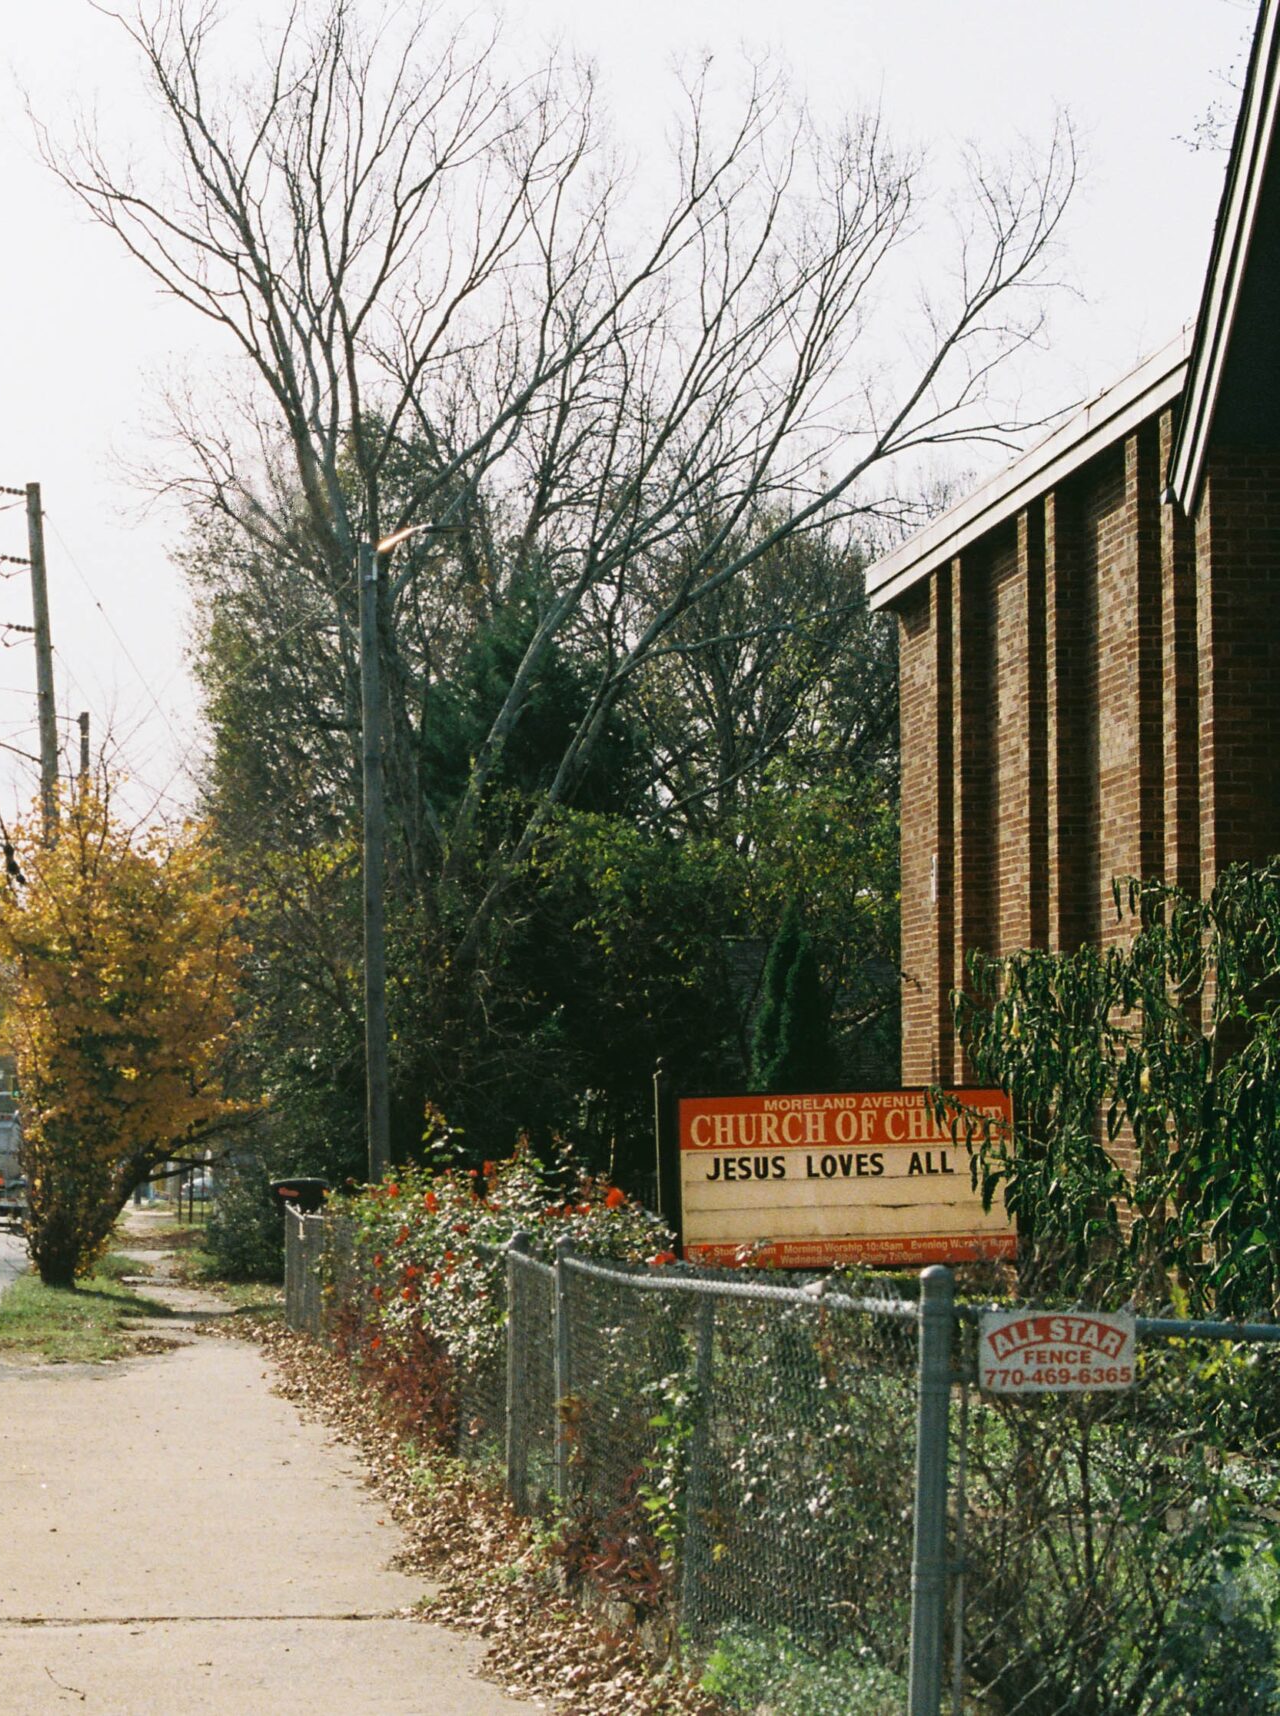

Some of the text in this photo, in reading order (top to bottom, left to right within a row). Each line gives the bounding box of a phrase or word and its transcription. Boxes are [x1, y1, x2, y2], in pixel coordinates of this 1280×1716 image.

[764, 1095, 925, 1111] MORELAND AVENUE
[690, 1110, 826, 1146] CHURCH
[834, 1109, 877, 1141] OF
[706, 1150, 954, 1181] JESUS LOVES ALL
[784, 1244, 821, 1255] Morning
[824, 1242, 863, 1254] Worship
[911, 1239, 948, 1251] Evening
[994, 1318, 1122, 1357] ALL STAR
[1024, 1350, 1092, 1364] FENCE
[984, 1367, 1132, 1386] 770-469-6365
